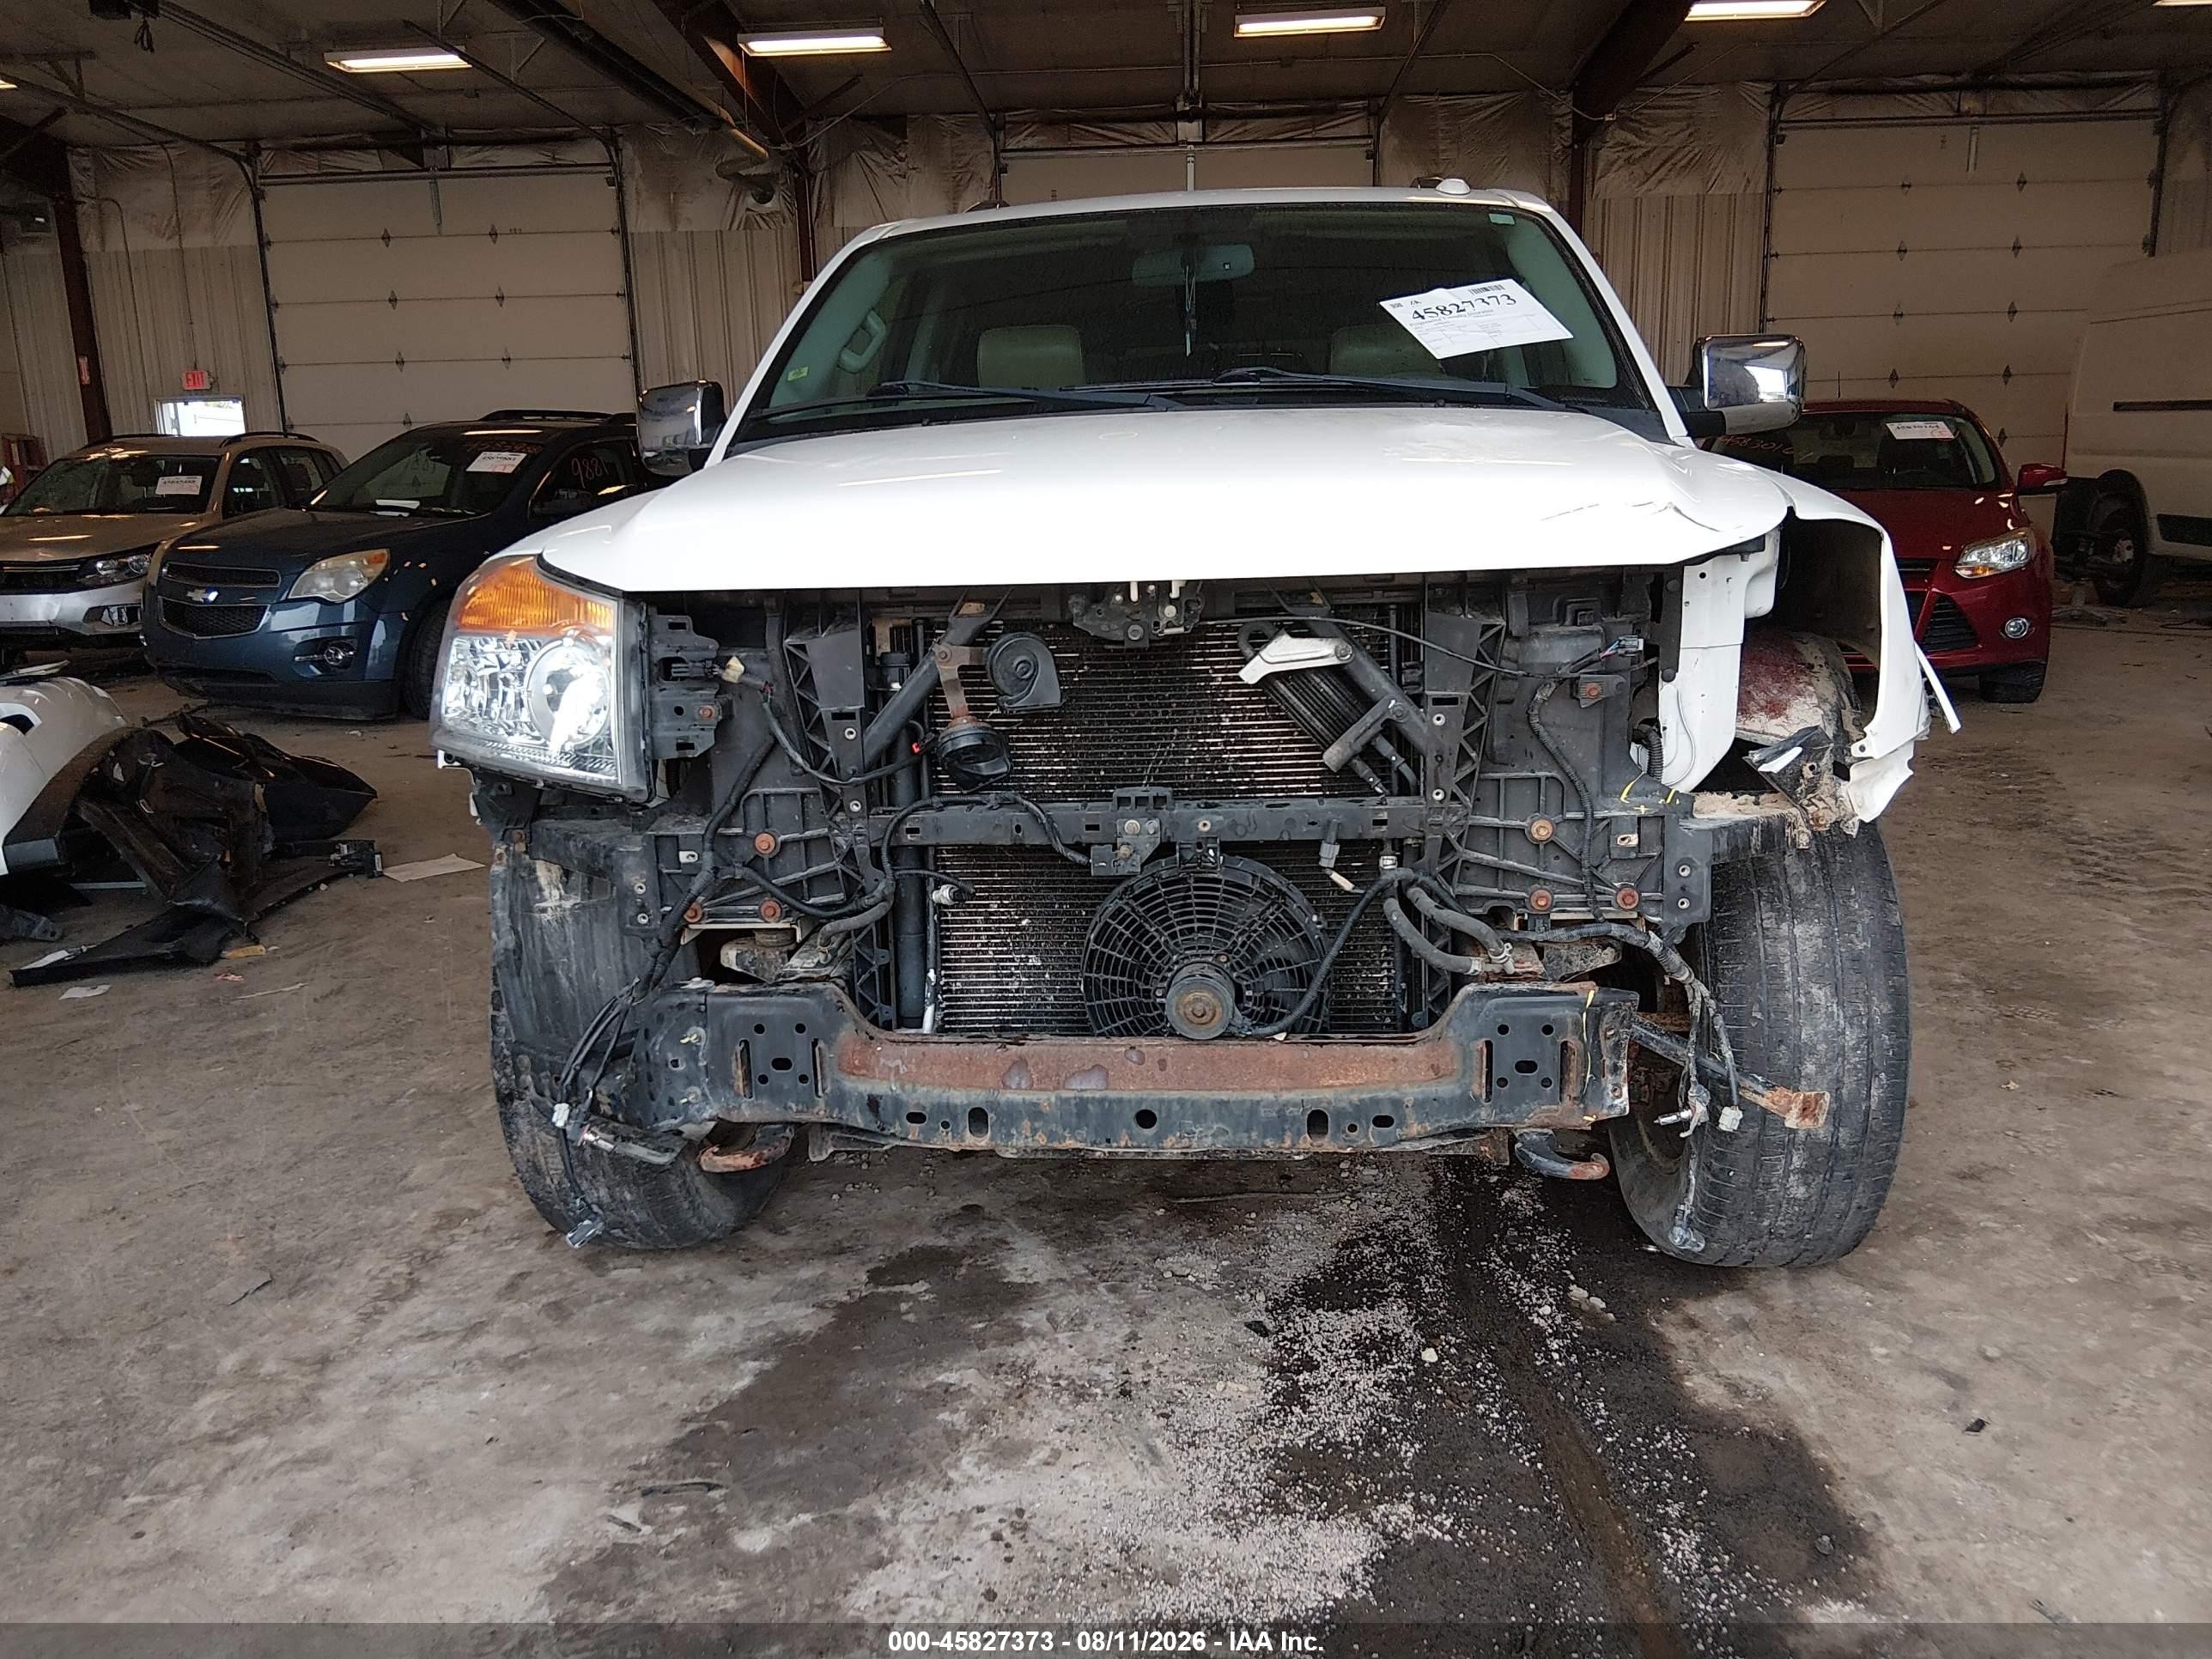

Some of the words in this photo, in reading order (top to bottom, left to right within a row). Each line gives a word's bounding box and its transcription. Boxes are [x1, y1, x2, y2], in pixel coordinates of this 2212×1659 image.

[1412, 294, 1516, 319] 45827373
[185, 371, 204, 386] EXIT
[571, 458, 609, 489] 9881
